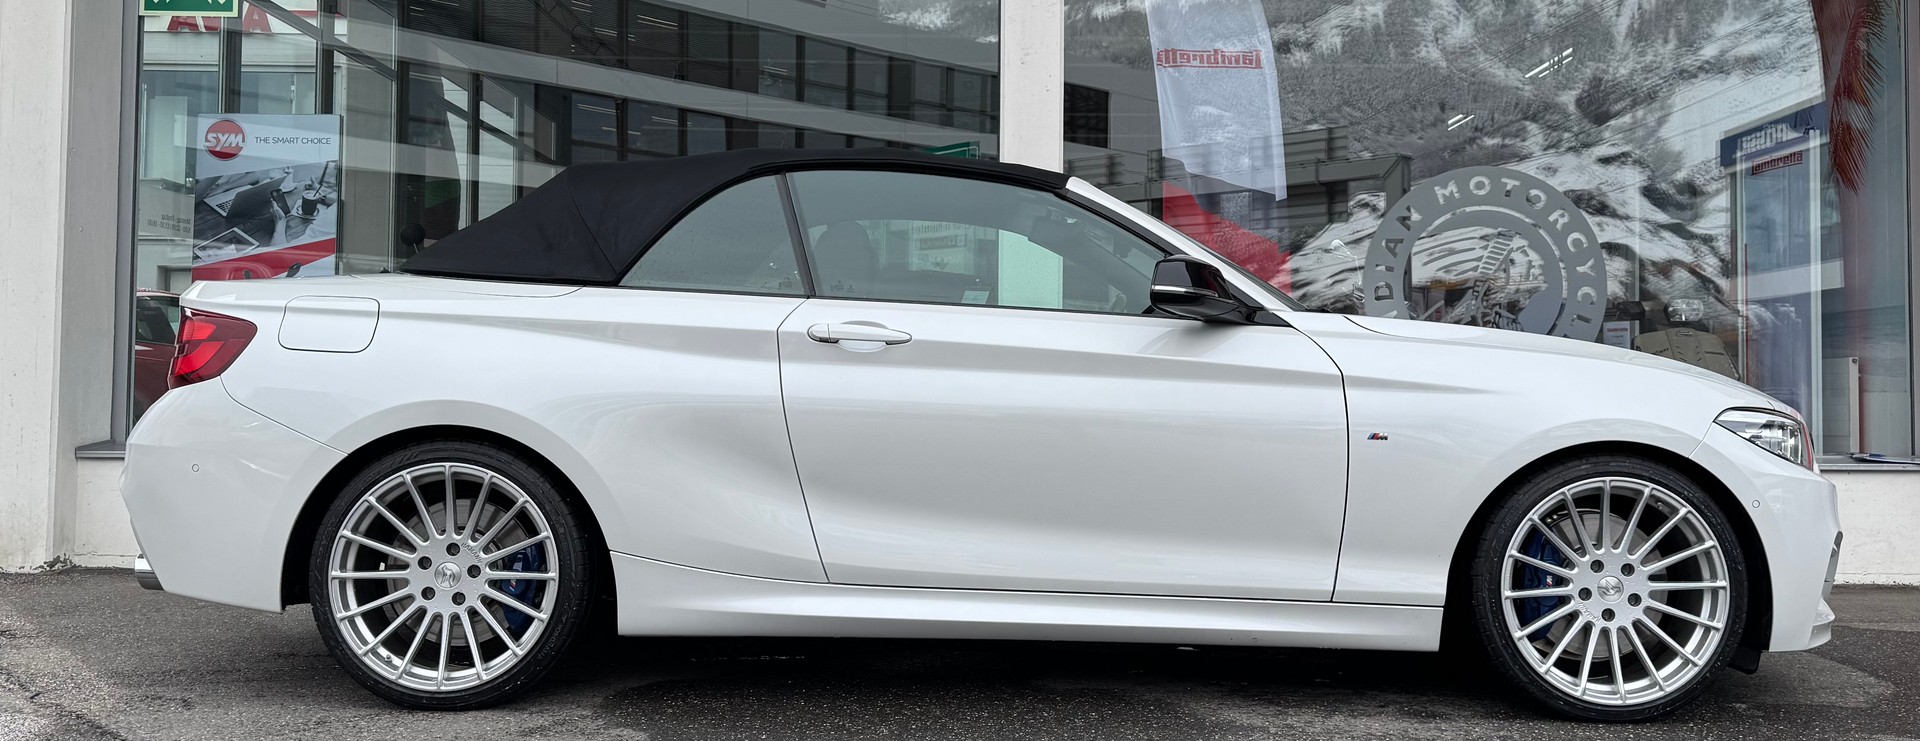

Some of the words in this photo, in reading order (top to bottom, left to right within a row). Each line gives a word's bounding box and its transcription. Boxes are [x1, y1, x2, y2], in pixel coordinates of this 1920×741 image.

[203, 132, 245, 151] SYM
[254, 136, 271, 144] THE
[272, 136, 300, 145] SMART
[301, 137, 331, 145] CHOICE
[1374, 205, 1423, 318] DIAN
